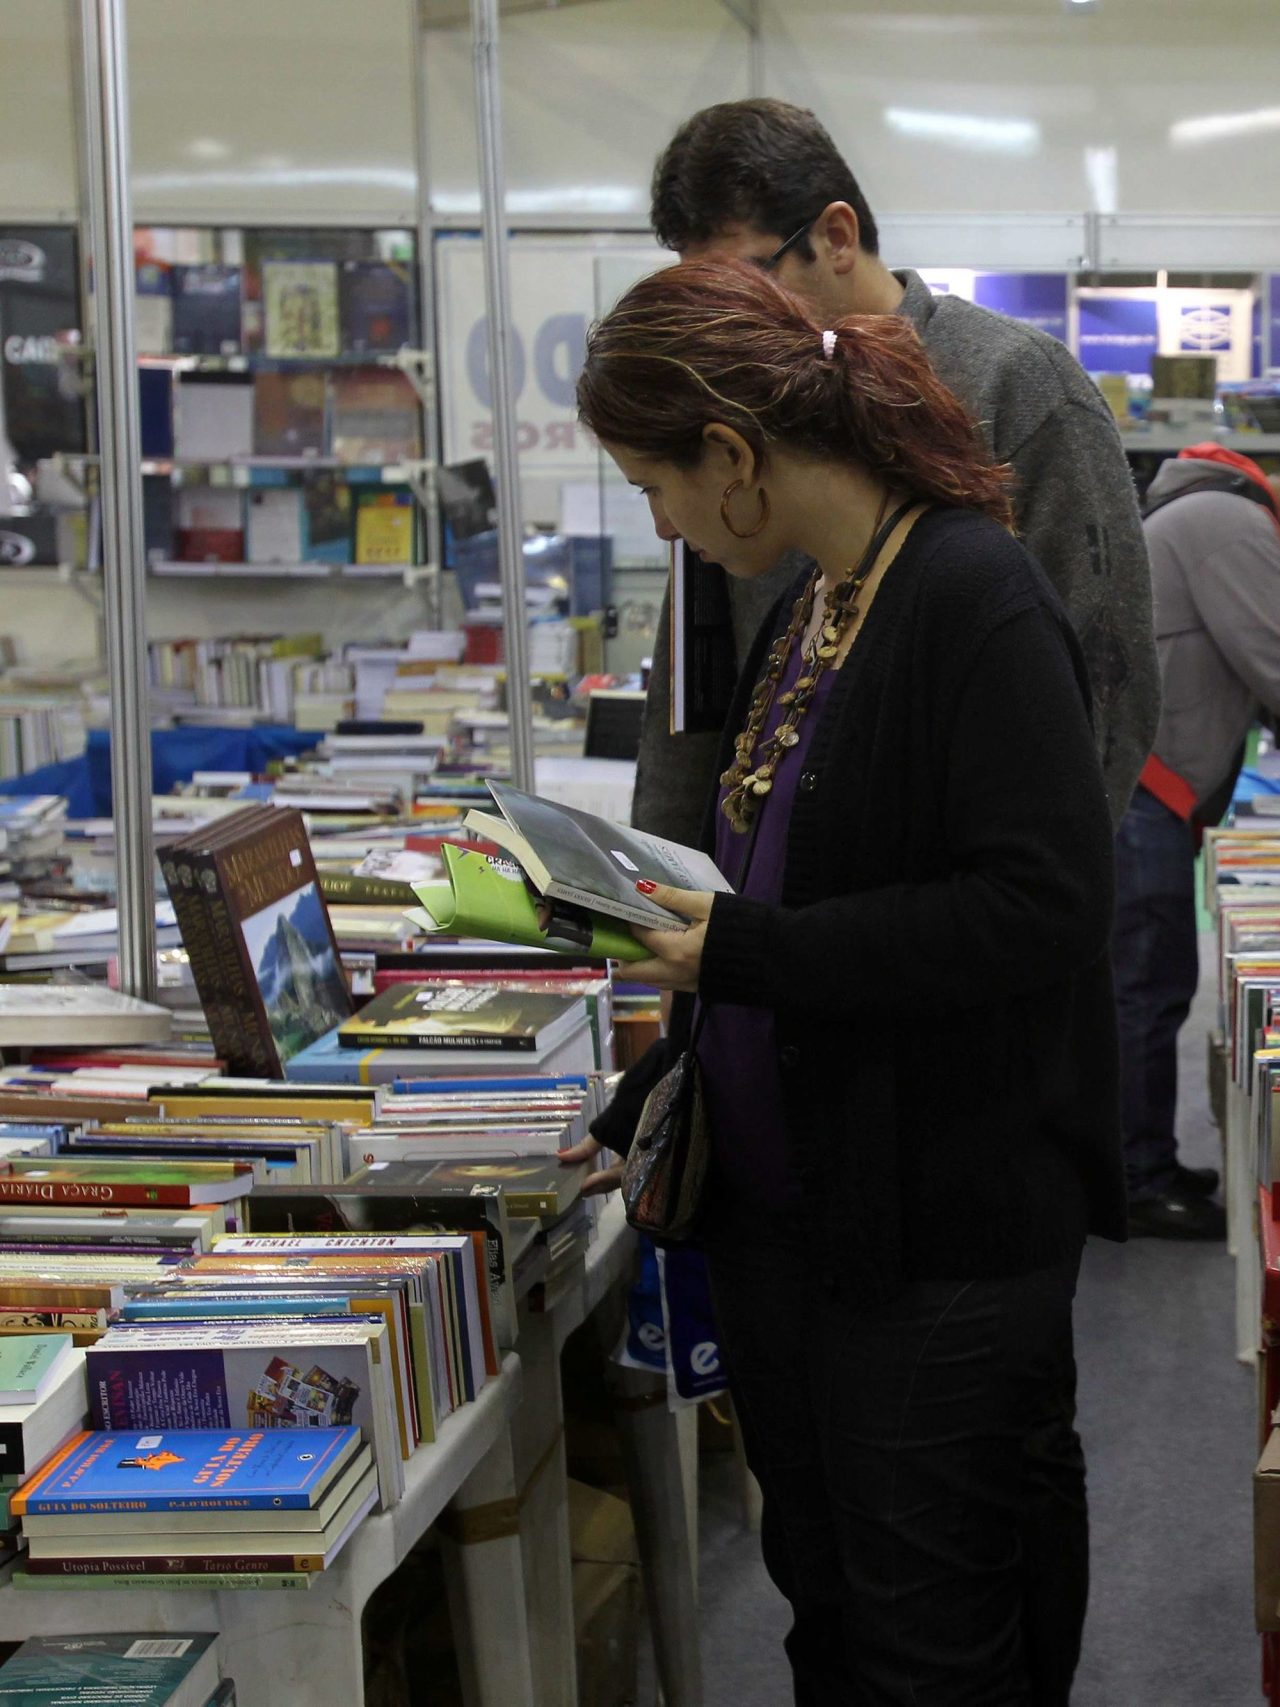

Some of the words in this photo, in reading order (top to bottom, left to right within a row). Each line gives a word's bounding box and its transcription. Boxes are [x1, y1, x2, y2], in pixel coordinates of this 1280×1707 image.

[0, 1182, 54, 1200] DIÁRIA
[62, 1183, 113, 1200] GRAÇA
[242, 1238, 302, 1247] MICHAEL
[326, 1238, 396, 1246] CRICHTON
[690, 1341, 719, 1375] e
[99, 1381, 110, 1419] ESCRITOR
[193, 1455, 227, 1484] GUIA
[218, 1437, 241, 1452] DO
[210, 1433, 265, 1487] SOLTEIRO
[38, 1503, 68, 1511] GUIA
[71, 1502, 87, 1510] DO
[90, 1501, 147, 1510] SOLTEIRO
[62, 1560, 102, 1573] Utopia
[103, 1559, 146, 1571] Possível
[203, 1559, 233, 1570] Tarso
[234, 1559, 269, 1570] Genro
